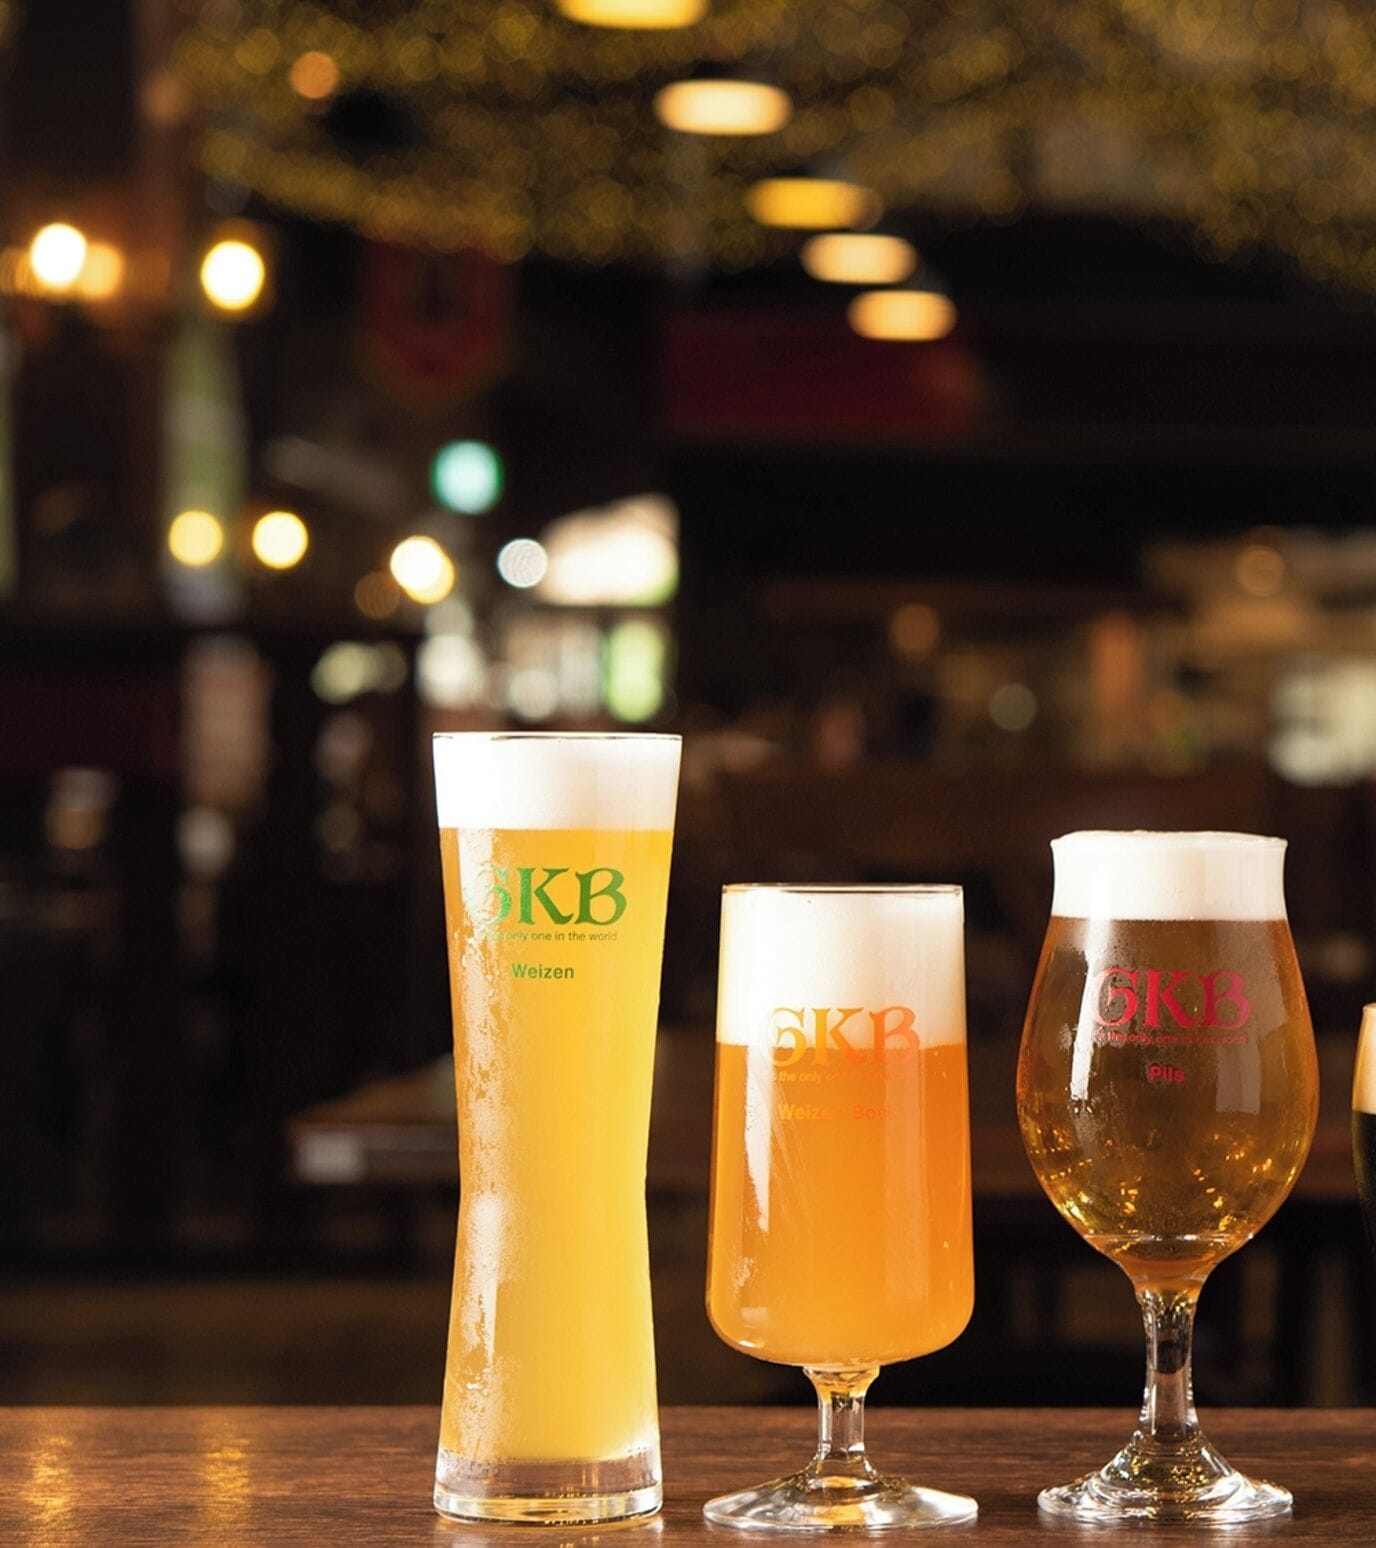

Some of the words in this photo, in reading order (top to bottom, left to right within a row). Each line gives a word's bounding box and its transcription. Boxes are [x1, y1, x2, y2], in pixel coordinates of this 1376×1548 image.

[531, 932, 552, 941] one
[555, 930, 565, 941] in
[568, 930, 587, 941] the
[589, 930, 617, 941] world
[512, 963, 575, 979] Weizen
[1094, 967, 1252, 1029] GKB
[763, 1005, 921, 1067] GKB
[779, 1071, 797, 1082] the
[799, 1071, 824, 1083] only
[1148, 1064, 1186, 1083] Pils
